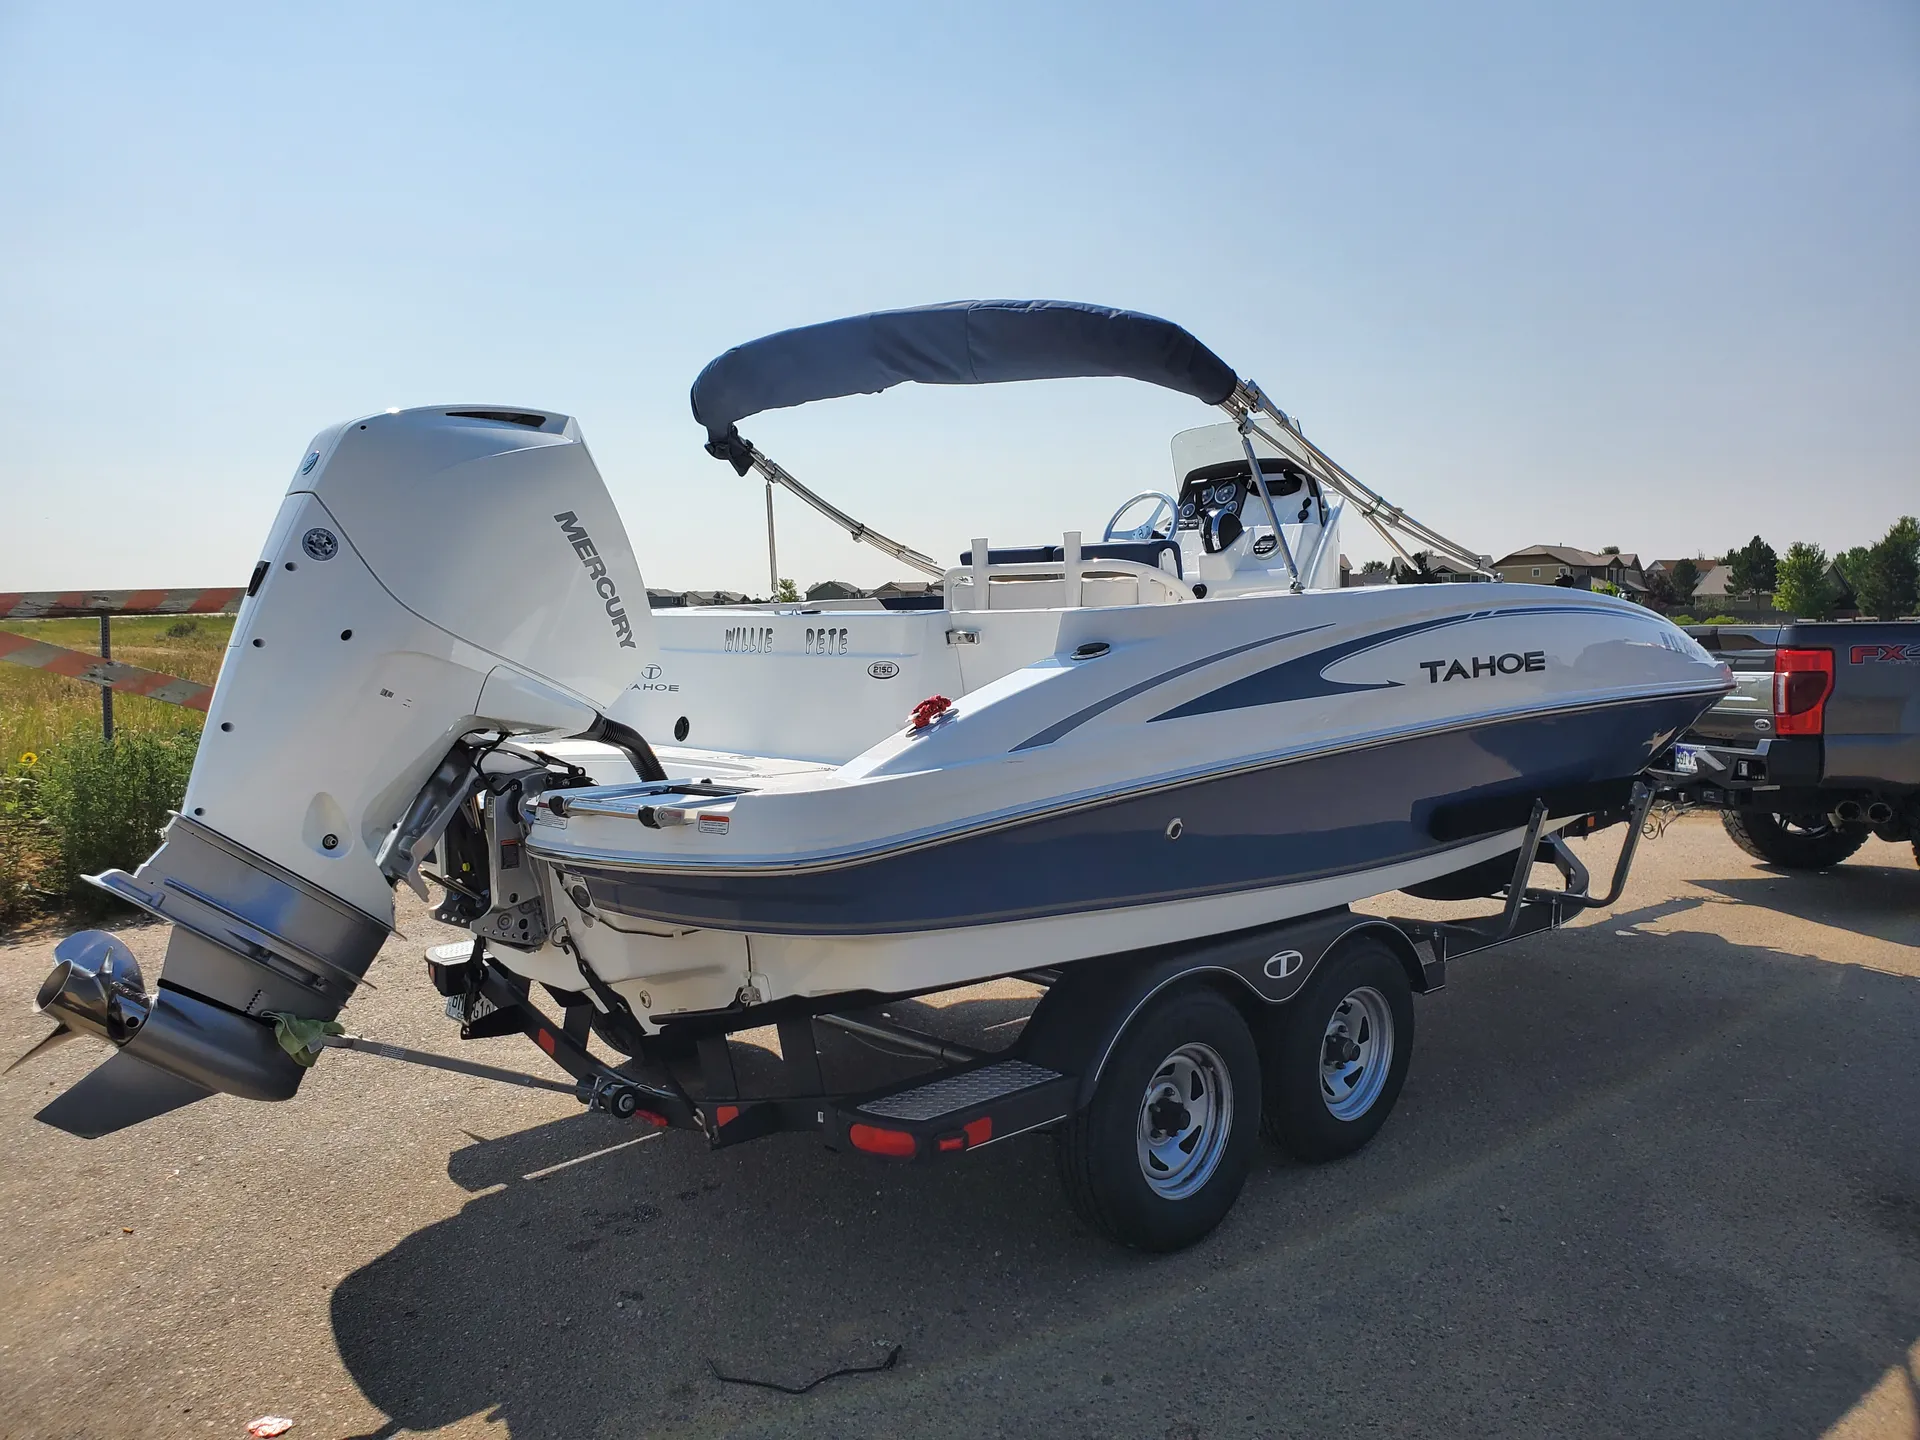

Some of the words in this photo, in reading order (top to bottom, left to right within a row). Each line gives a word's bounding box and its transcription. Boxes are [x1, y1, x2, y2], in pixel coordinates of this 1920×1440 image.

[553, 510, 637, 649] MERCURY
[724, 626, 774, 654] WILLIE
[805, 627, 848, 656] PETE
[873, 666, 893, 674] 2150
[1419, 650, 1546, 684] TAHOE
[625, 683, 680, 692] AHOE
